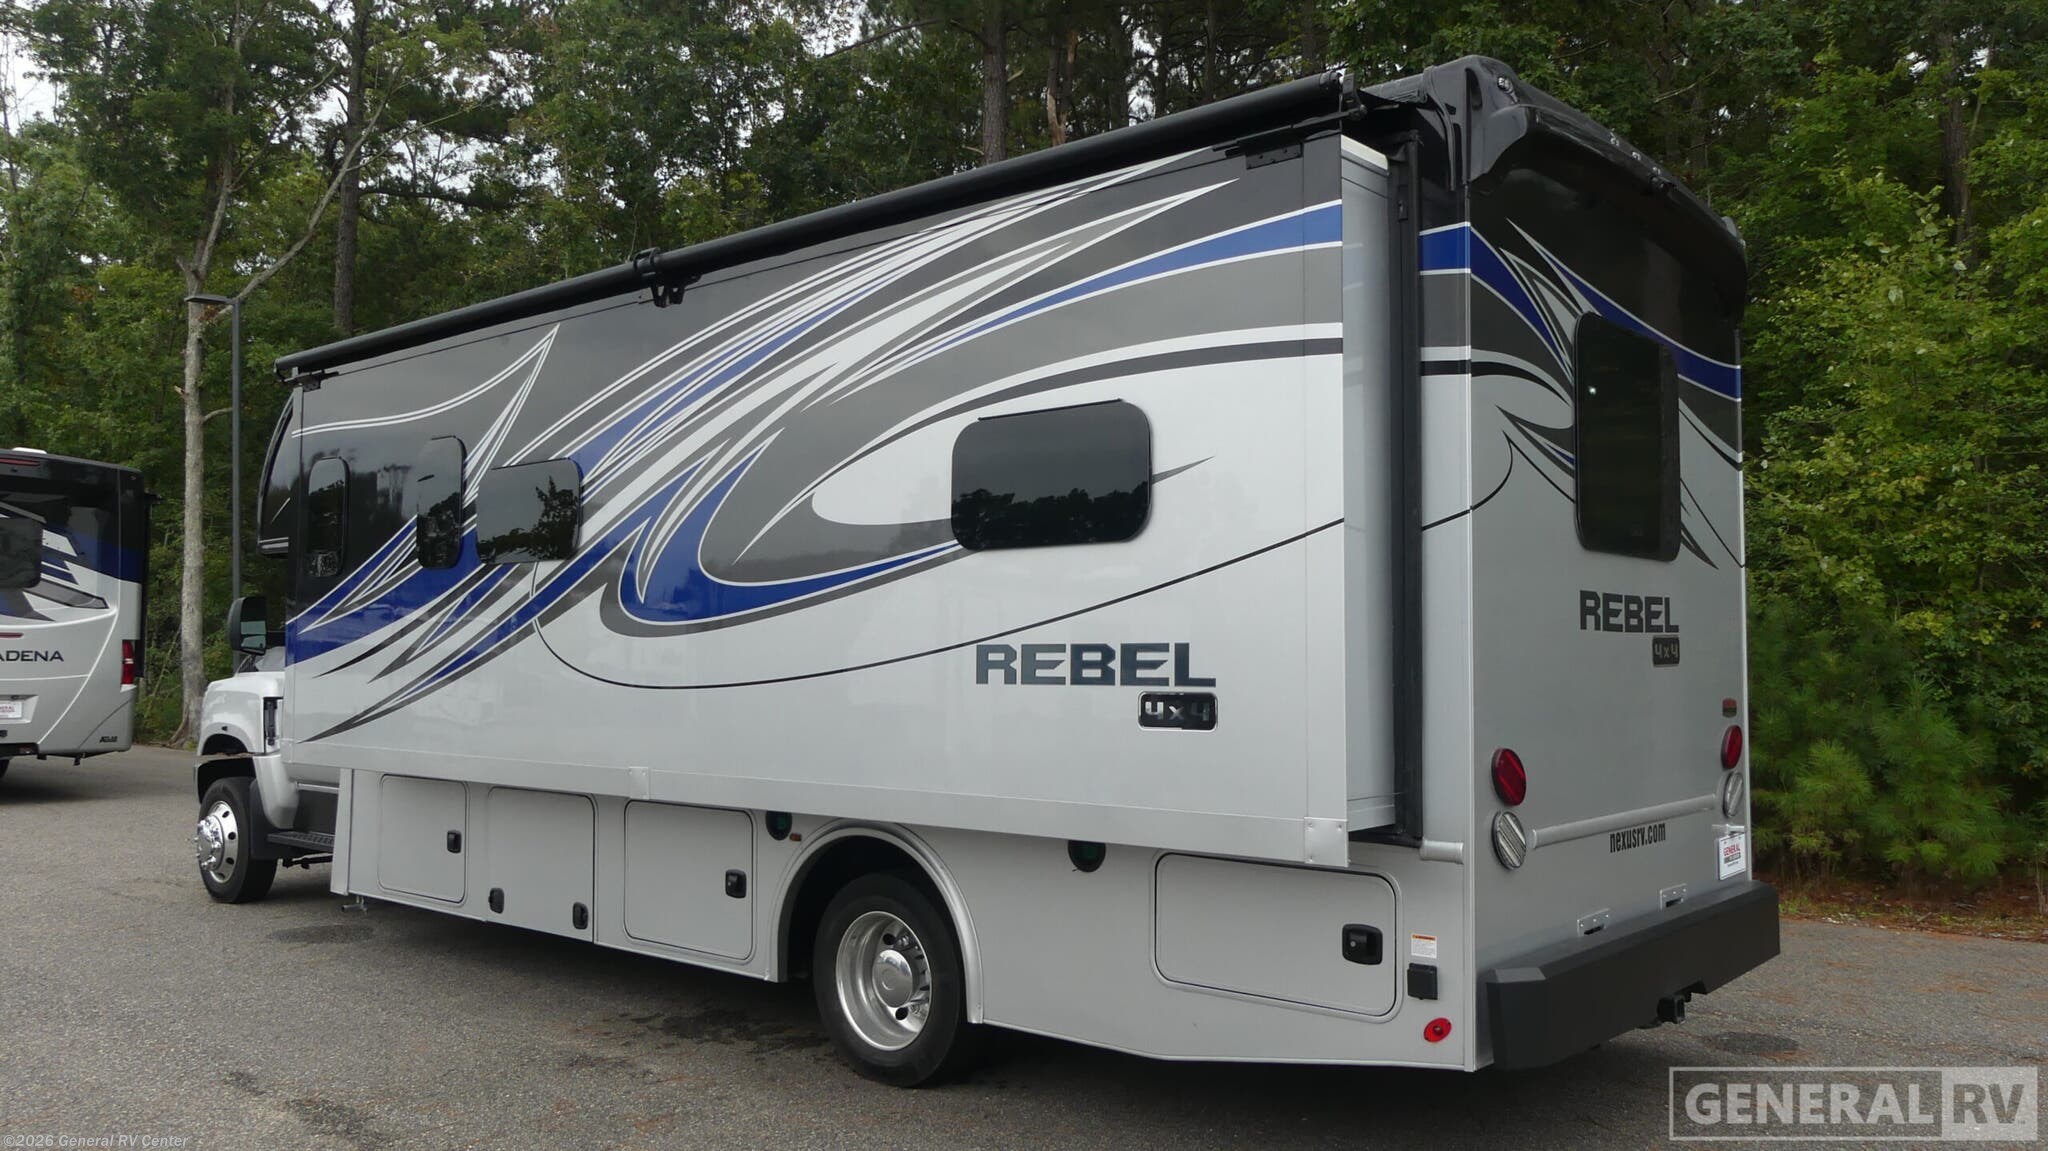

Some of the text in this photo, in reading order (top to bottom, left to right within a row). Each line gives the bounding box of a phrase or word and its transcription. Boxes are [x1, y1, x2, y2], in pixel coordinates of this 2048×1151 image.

[1580, 590, 1680, 633] REBEL
[976, 642, 1217, 687] REBEL
[1654, 642, 1678, 659] 4x4
[1144, 701, 1211, 721] 4x4
[1609, 822, 1666, 853] nexusrv.com
